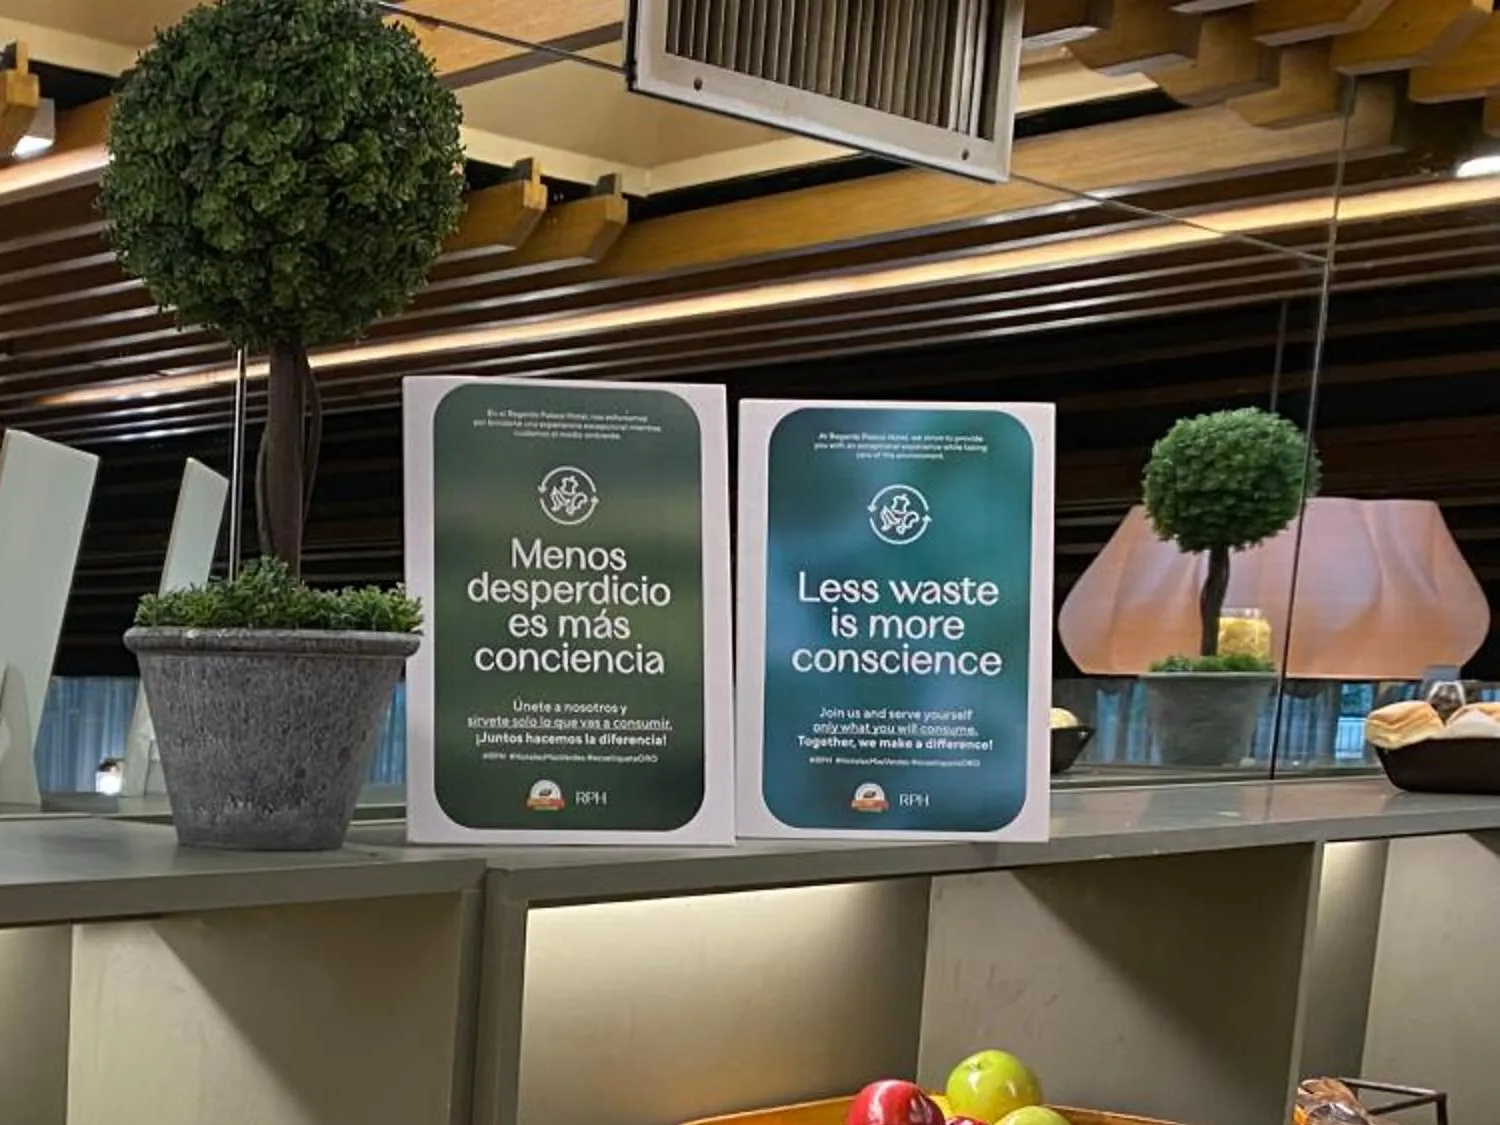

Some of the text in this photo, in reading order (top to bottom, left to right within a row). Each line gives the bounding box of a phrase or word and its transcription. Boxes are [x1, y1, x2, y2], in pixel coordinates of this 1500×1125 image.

[511, 538, 627, 571] Menos
[467, 572, 671, 609] desperdicio
[799, 571, 999, 606] Less waste
[508, 608, 631, 639] es más
[831, 606, 965, 640] is more
[474, 642, 665, 674] conciencia
[791, 644, 1002, 676] conscience
[513, 696, 627, 716] Únete a nosotros y
[819, 707, 973, 721] Join us and serve yourself
[554, 719, 578, 730] que
[579, 720, 600, 730] vas
[603, 720, 610, 730] a
[813, 722, 838, 734] only
[840, 722, 869, 733] what
[873, 725, 895, 735] you
[898, 723, 917, 734] will
[475, 732, 667, 746] ¡Juntos hacemos la diferencia!
[798, 736, 993, 750] Together, we make a difference!
[575, 791, 607, 805] RPH
[899, 793, 929, 806] RPH
